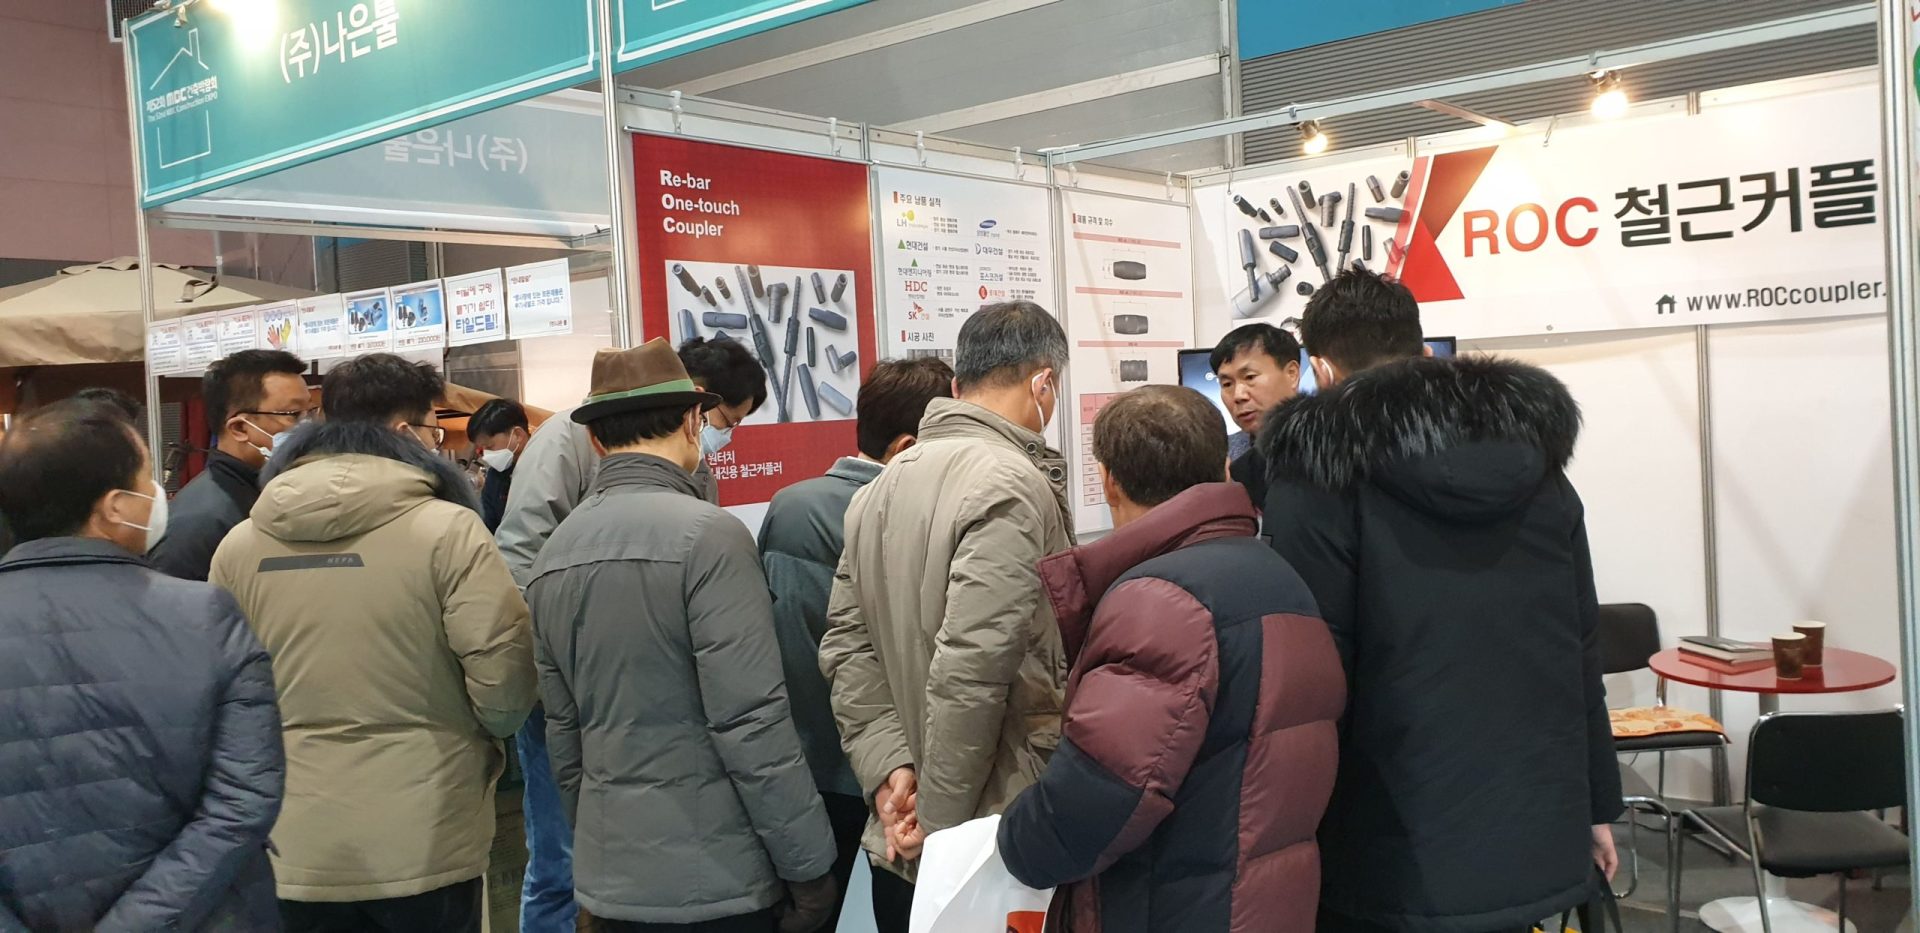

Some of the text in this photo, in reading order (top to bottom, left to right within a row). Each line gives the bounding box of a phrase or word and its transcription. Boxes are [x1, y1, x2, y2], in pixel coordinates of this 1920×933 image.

[660, 169, 711, 190] Re-bar
[661, 193, 740, 216] One-touch
[663, 217, 723, 238] Coupler
[1464, 197, 1599, 258] ROC
[904, 281, 928, 292] HDC
[455, 313, 499, 334] 타일드릴!
[908, 311, 917, 320] SK
[908, 332, 934, 342] 시공 사진
[708, 450, 735, 465] 원터치
[740, 461, 783, 478] 철근커플러
